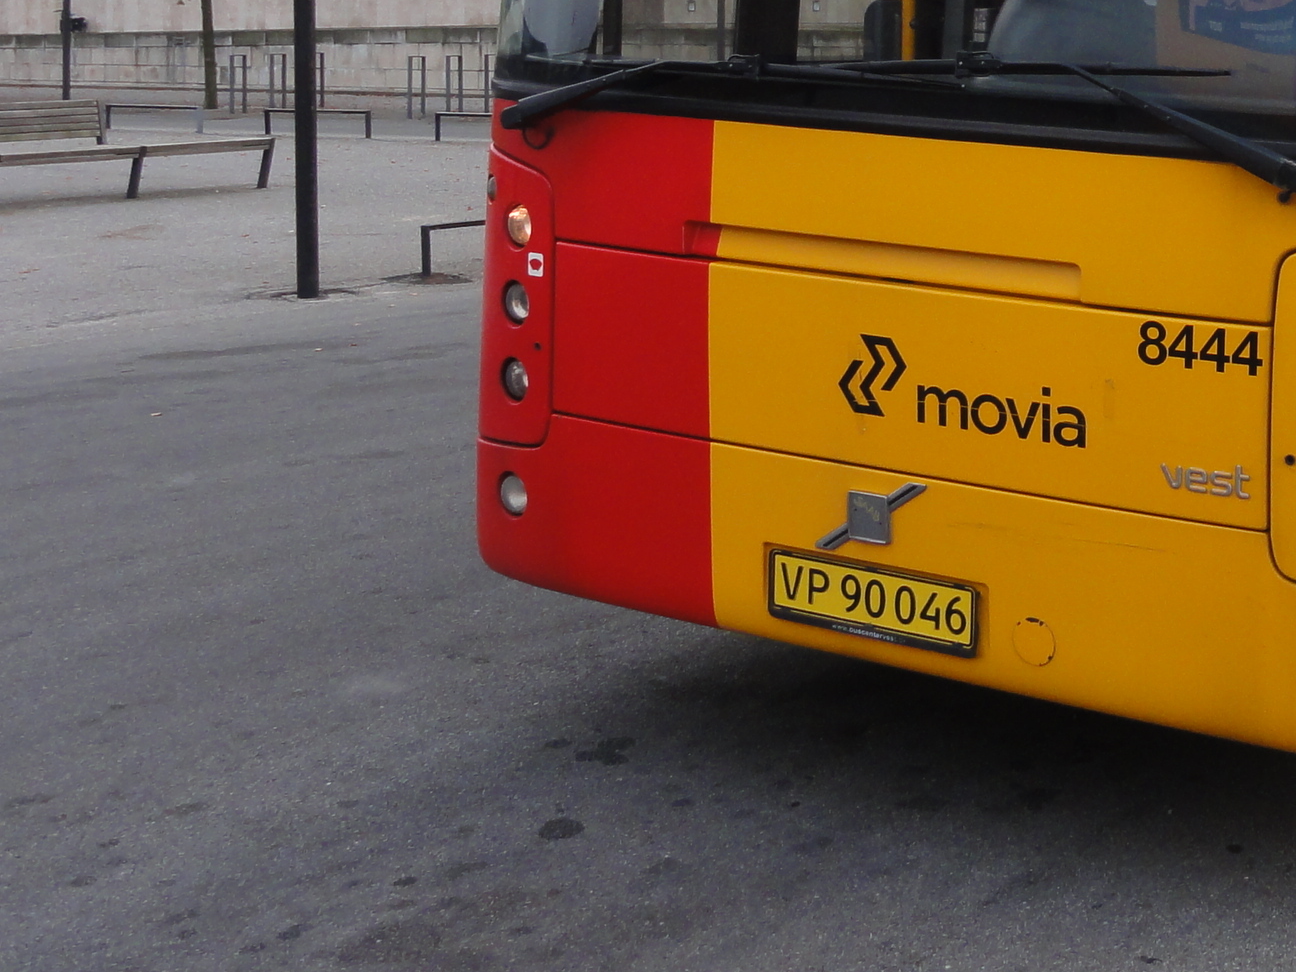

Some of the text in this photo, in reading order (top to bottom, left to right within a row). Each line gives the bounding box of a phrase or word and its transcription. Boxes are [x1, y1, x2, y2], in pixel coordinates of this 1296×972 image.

[1136, 320, 1264, 377] 8444
[916, 383, 1088, 449] movia
[1160, 463, 1251, 500] vest
[780, 561, 968, 636] VP 90 046
